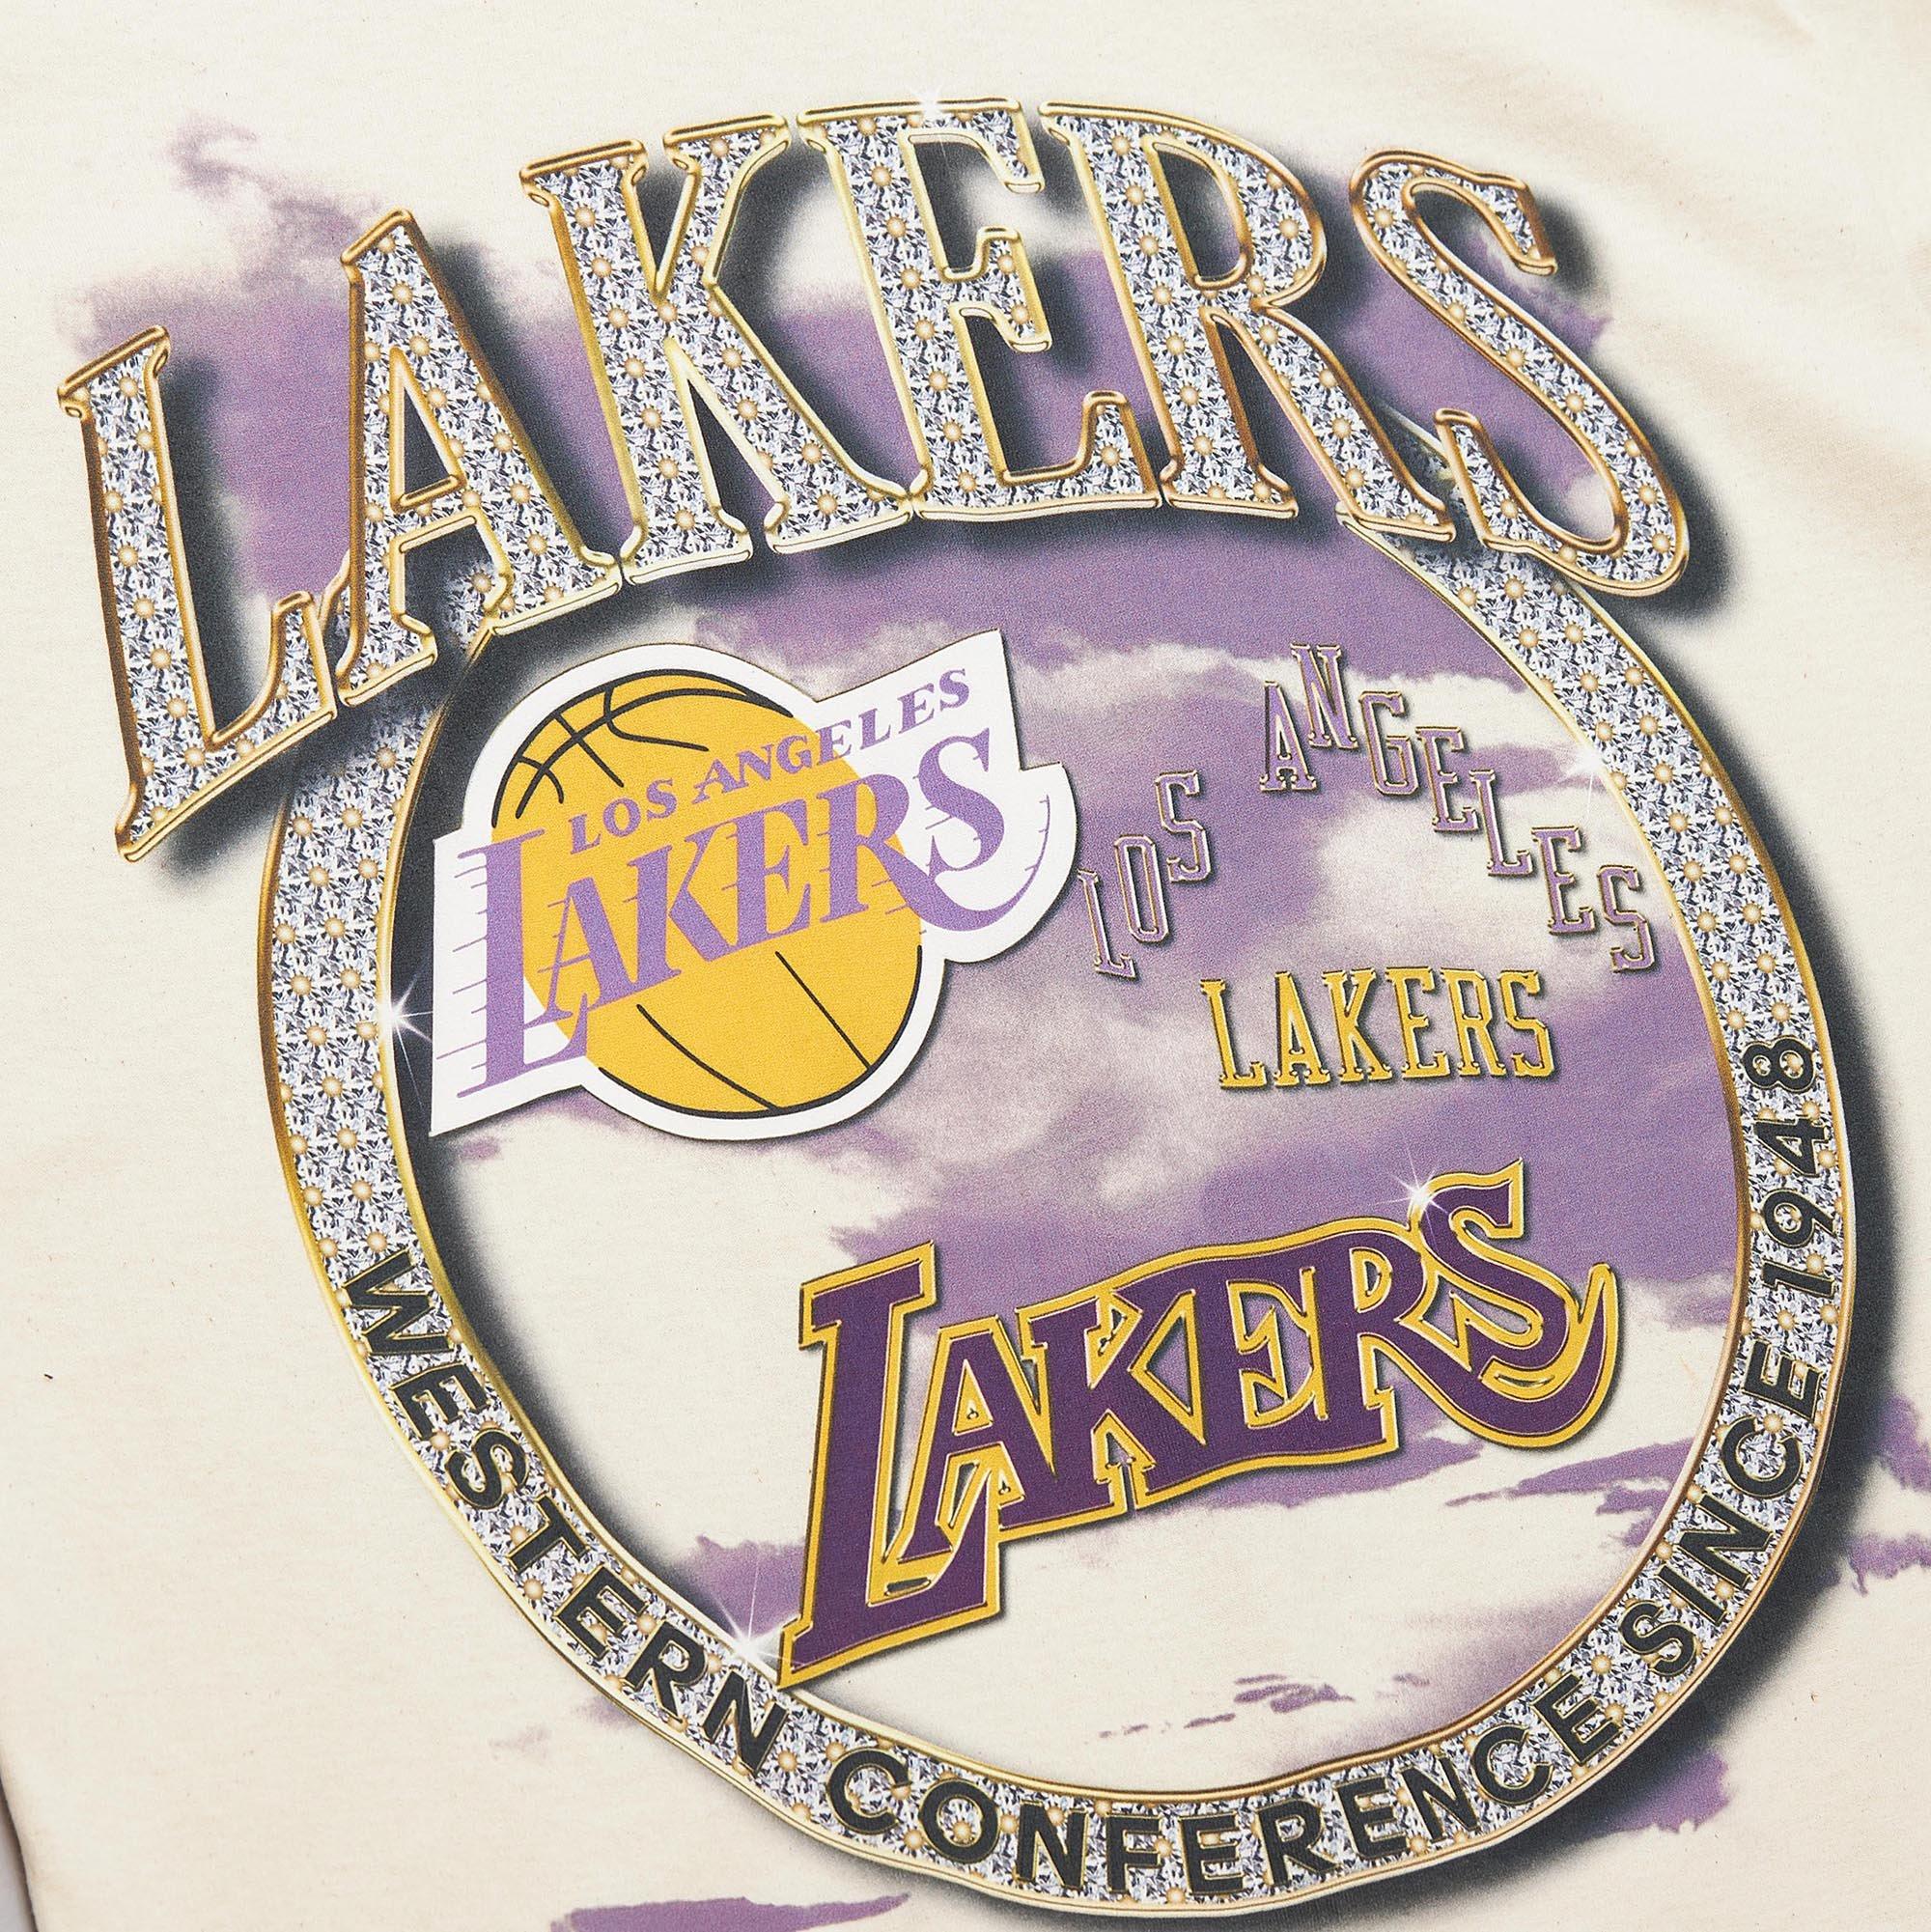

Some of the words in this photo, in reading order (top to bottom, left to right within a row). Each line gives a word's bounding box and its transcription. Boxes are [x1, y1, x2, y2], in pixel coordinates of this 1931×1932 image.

[58, 98, 1689, 863] LAKERS
[456, 728, 1051, 1099] LAKERS
[569, 778, 678, 854] LOS
[692, 668, 970, 804] ANGELES
[1077, 769, 1214, 979] LOS
[1258, 643, 1655, 974] ANGELES
[1200, 966, 1555, 1089] LAKERS
[341, 1246, 790, 1777] WESTERN
[825, 1672, 1622, 1895] CONFERENCE
[1619, 1338, 1826, 1678] SINCE
[1740, 1038, 1839, 1300] 1948
[777, 1158, 1619, 1688] LAKERS
